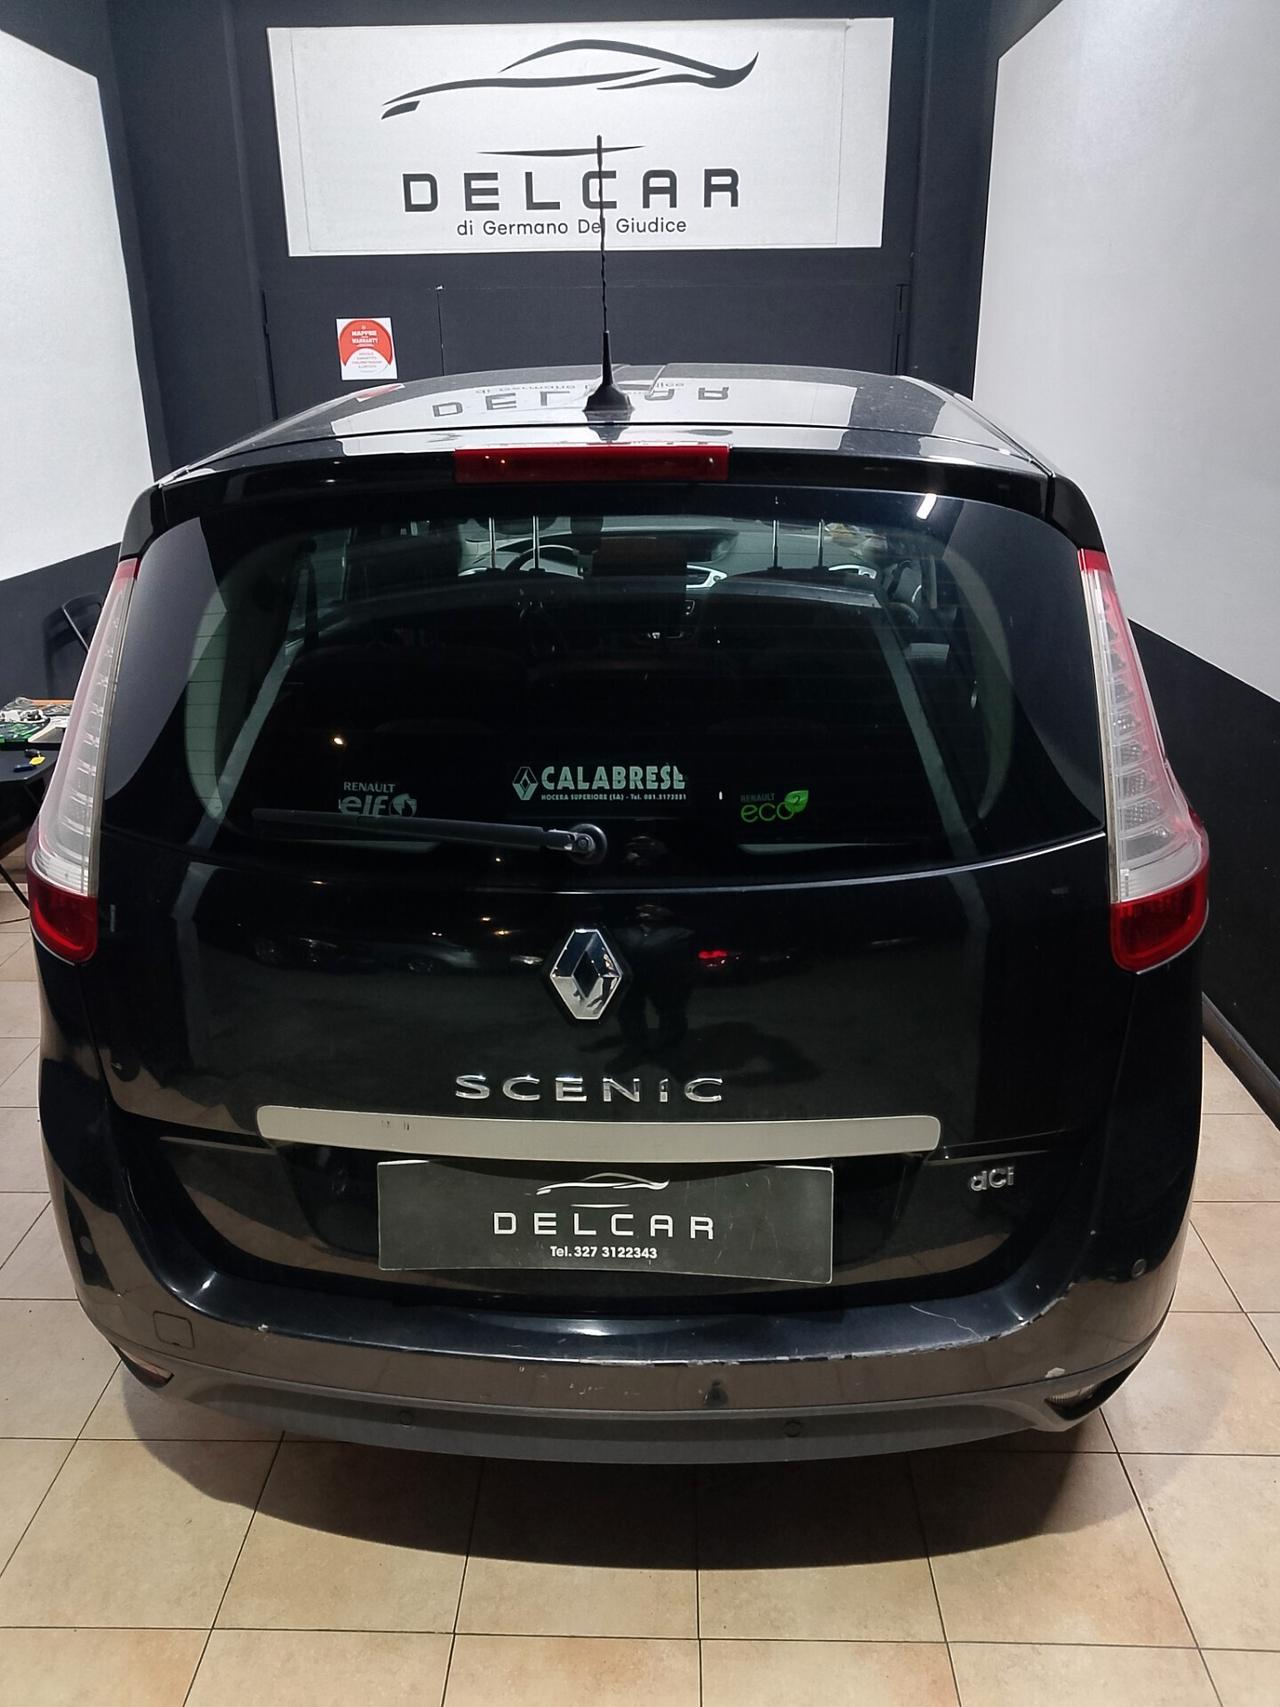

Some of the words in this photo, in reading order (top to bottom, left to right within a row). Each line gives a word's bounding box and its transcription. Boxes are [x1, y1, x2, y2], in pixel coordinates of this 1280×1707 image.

[402, 168, 739, 212] DELCAR
[456, 220, 473, 236] di
[482, 219, 569, 236] Germano
[616, 217, 688, 234] Giudice
[343, 781, 396, 793] RENAULT
[541, 765, 686, 790] CALABRESE
[970, 1166, 1015, 1192] dCi
[493, 1211, 715, 1240] DELCAR
[601, 1246, 658, 1259] 3122343
